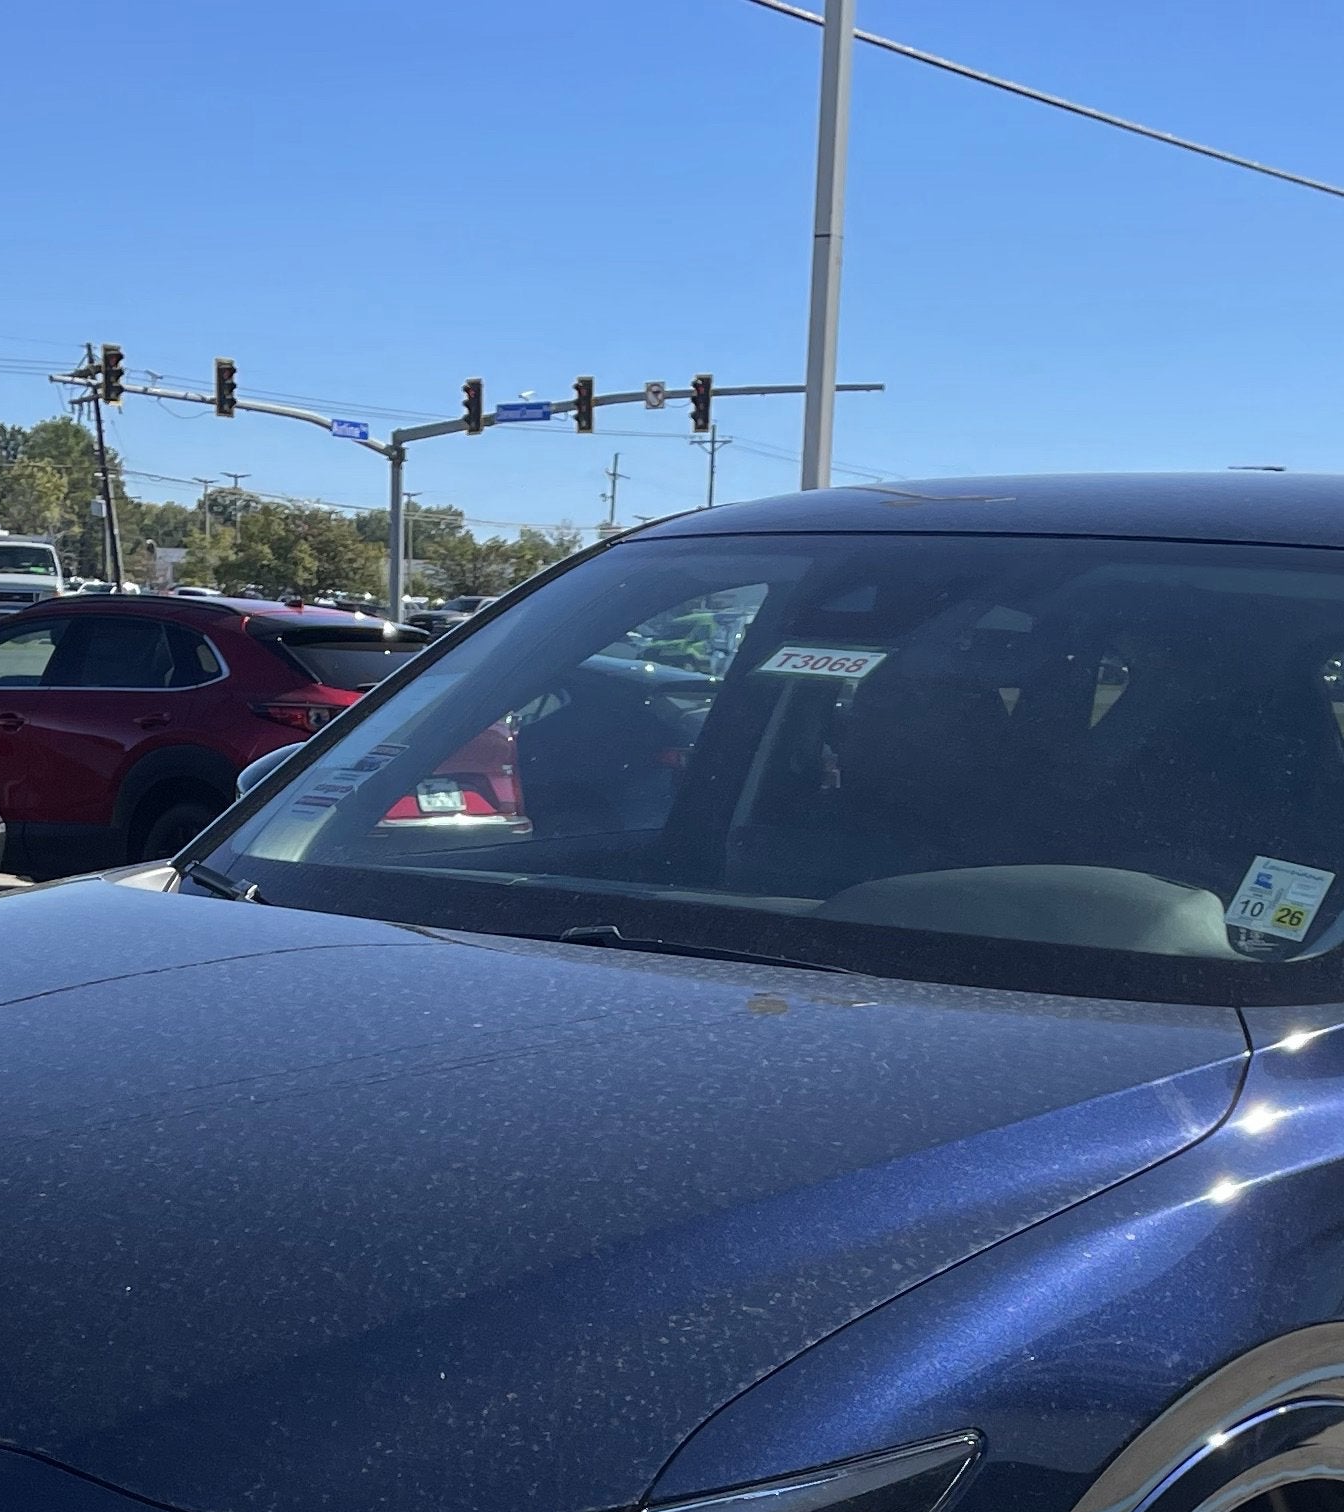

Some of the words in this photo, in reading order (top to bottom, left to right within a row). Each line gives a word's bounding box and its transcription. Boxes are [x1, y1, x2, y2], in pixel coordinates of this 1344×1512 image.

[775, 652, 869, 673] T3068
[1239, 899, 1265, 917] 10
[1275, 907, 1305, 927] 26
